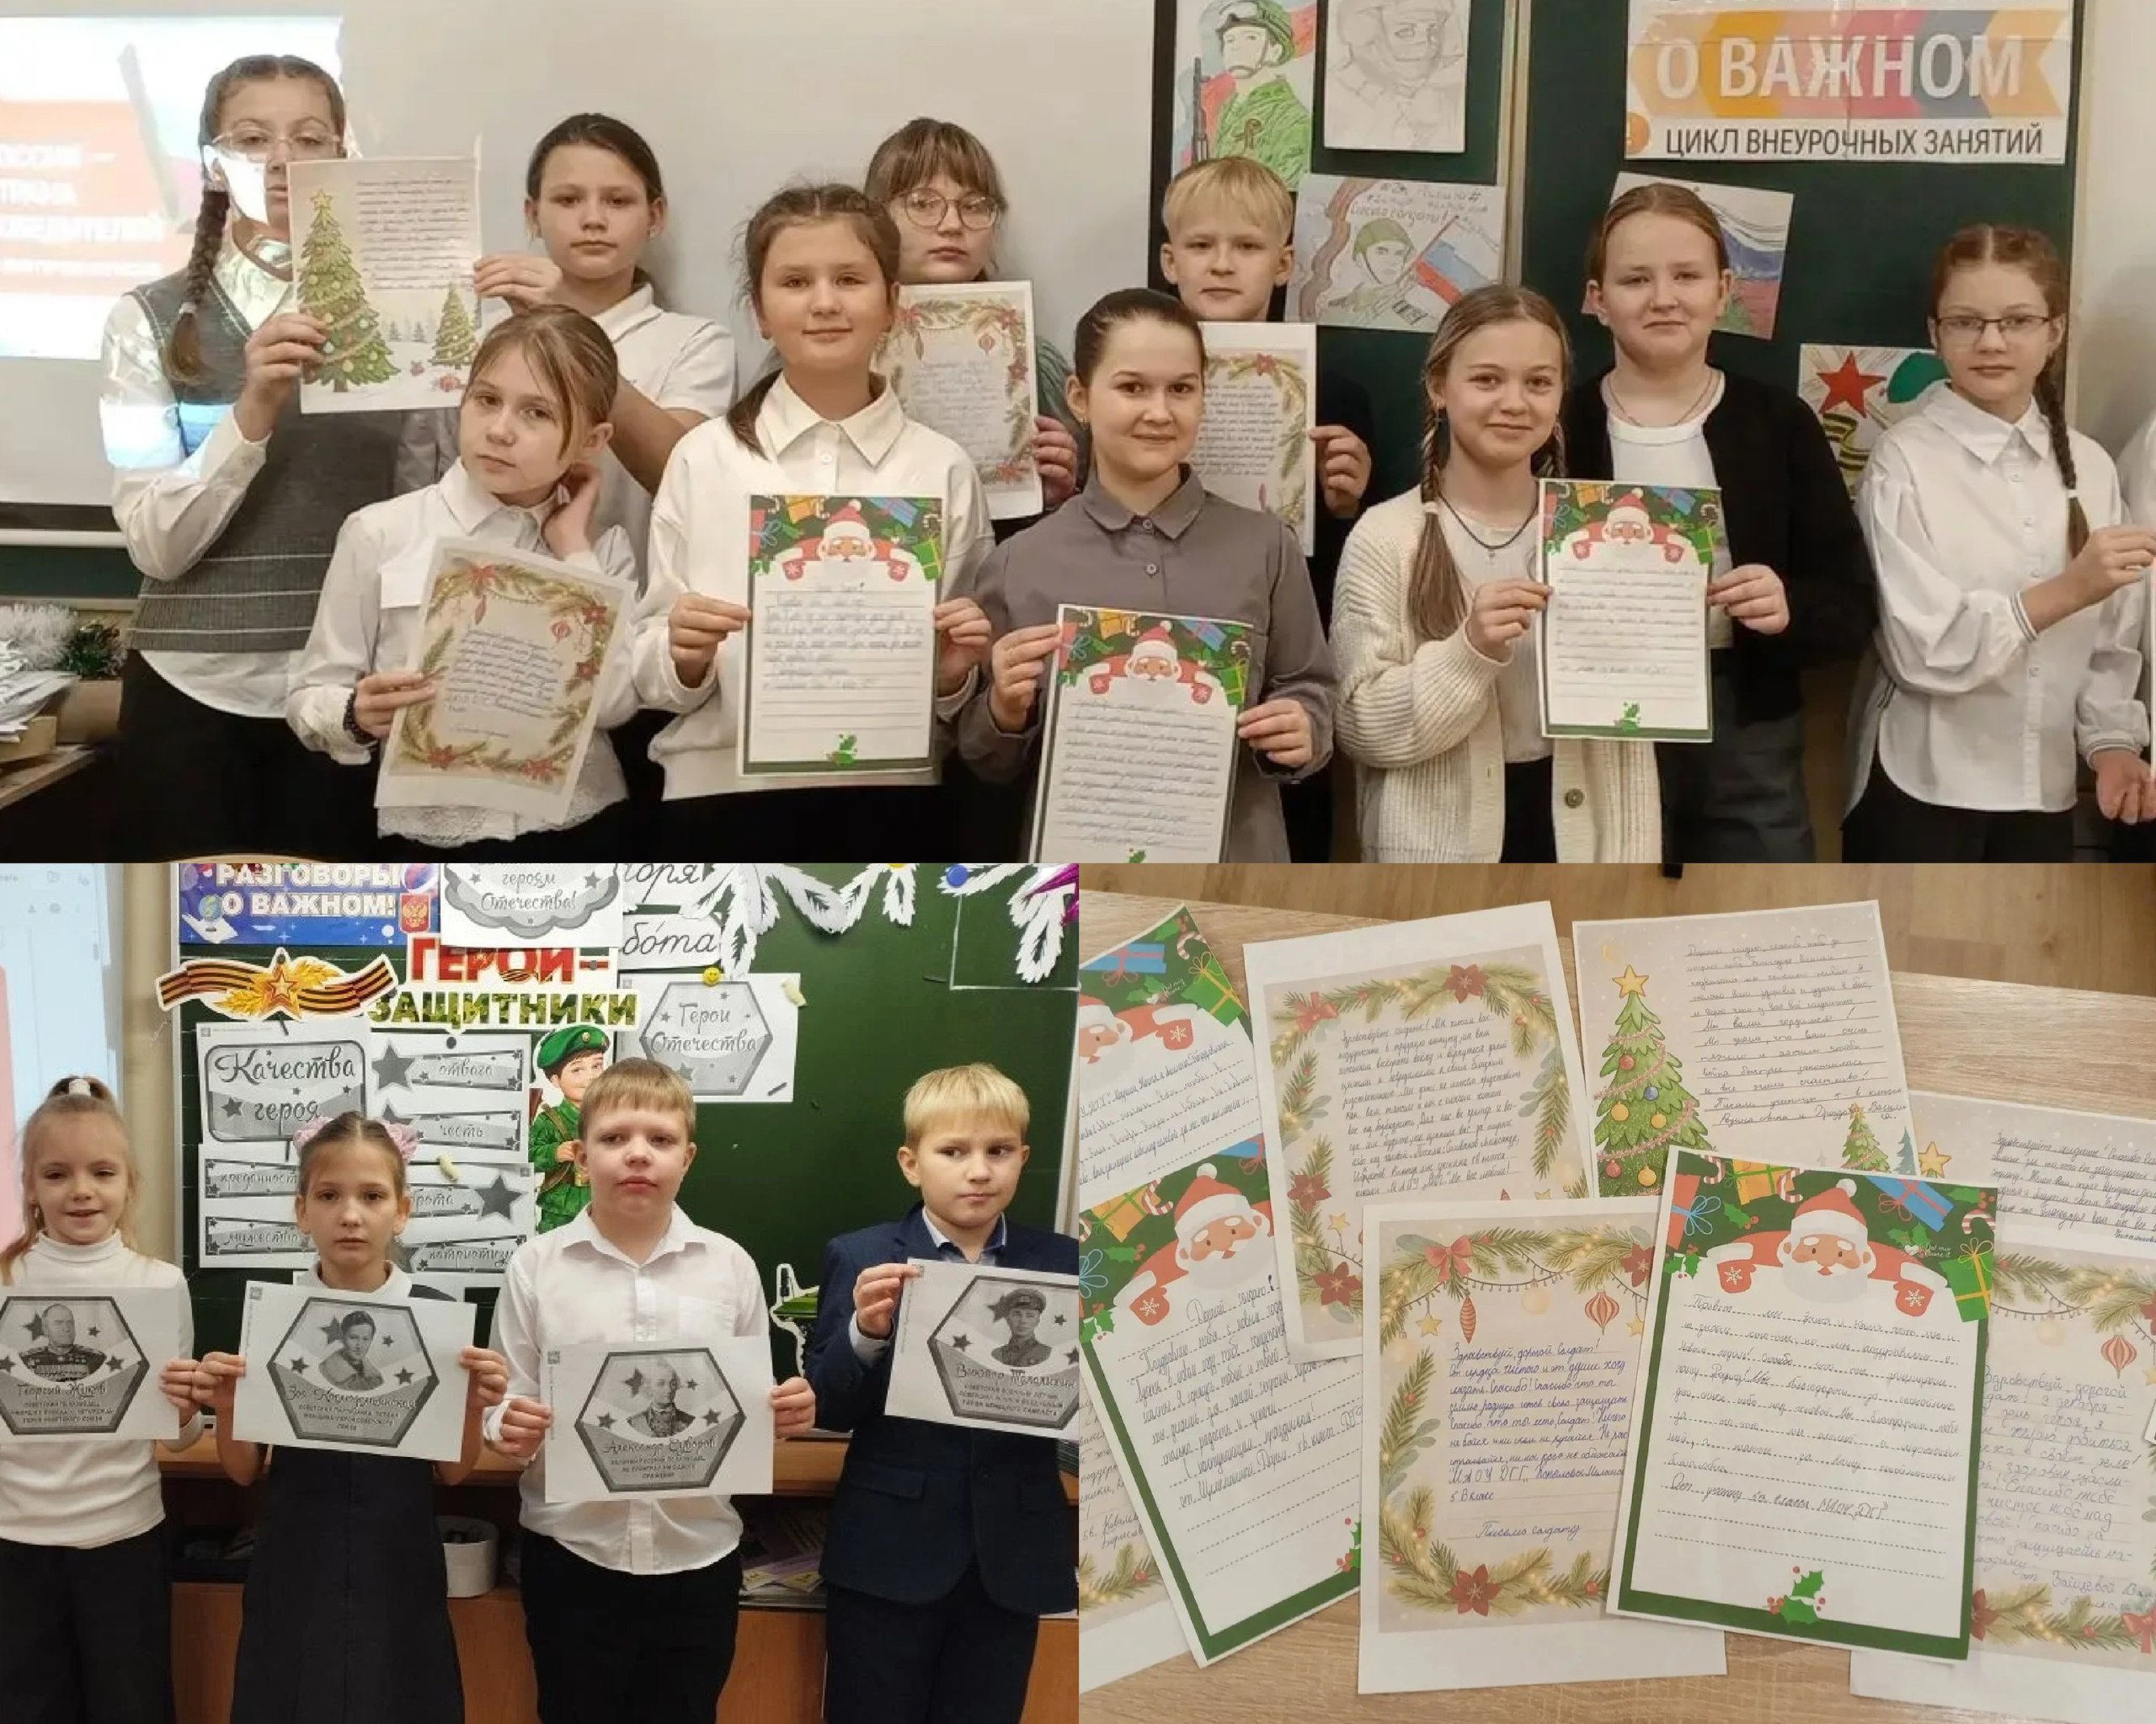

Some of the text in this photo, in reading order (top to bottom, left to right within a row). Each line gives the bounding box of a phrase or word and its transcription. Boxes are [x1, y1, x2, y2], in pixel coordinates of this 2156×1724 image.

[1657, 33, 2022, 100] О ВАЖНОМ
[1666, 122, 2042, 157] ЦИКЛ ВНЕУРОЧНЫХ ЗАНЯТИЙ
[216, 863, 401, 887] РАЗГОВОРЫ
[501, 873, 556, 894] героям
[221, 892, 397, 917] О ВАЖНОМ!
[481, 889, 578, 910] Отечества!
[368, 990, 638, 1030] ЗАЩИТНИКИ
[678, 1001, 731, 1035] Герои
[650, 1028, 757, 1053] Отечества
[214, 1046, 355, 1084] Качества
[438, 1059, 494, 1079] отвага
[253, 1100, 322, 1135] героя
[439, 1123, 484, 1139] честь
[1476, 1519, 1527, 1540] Письмо
